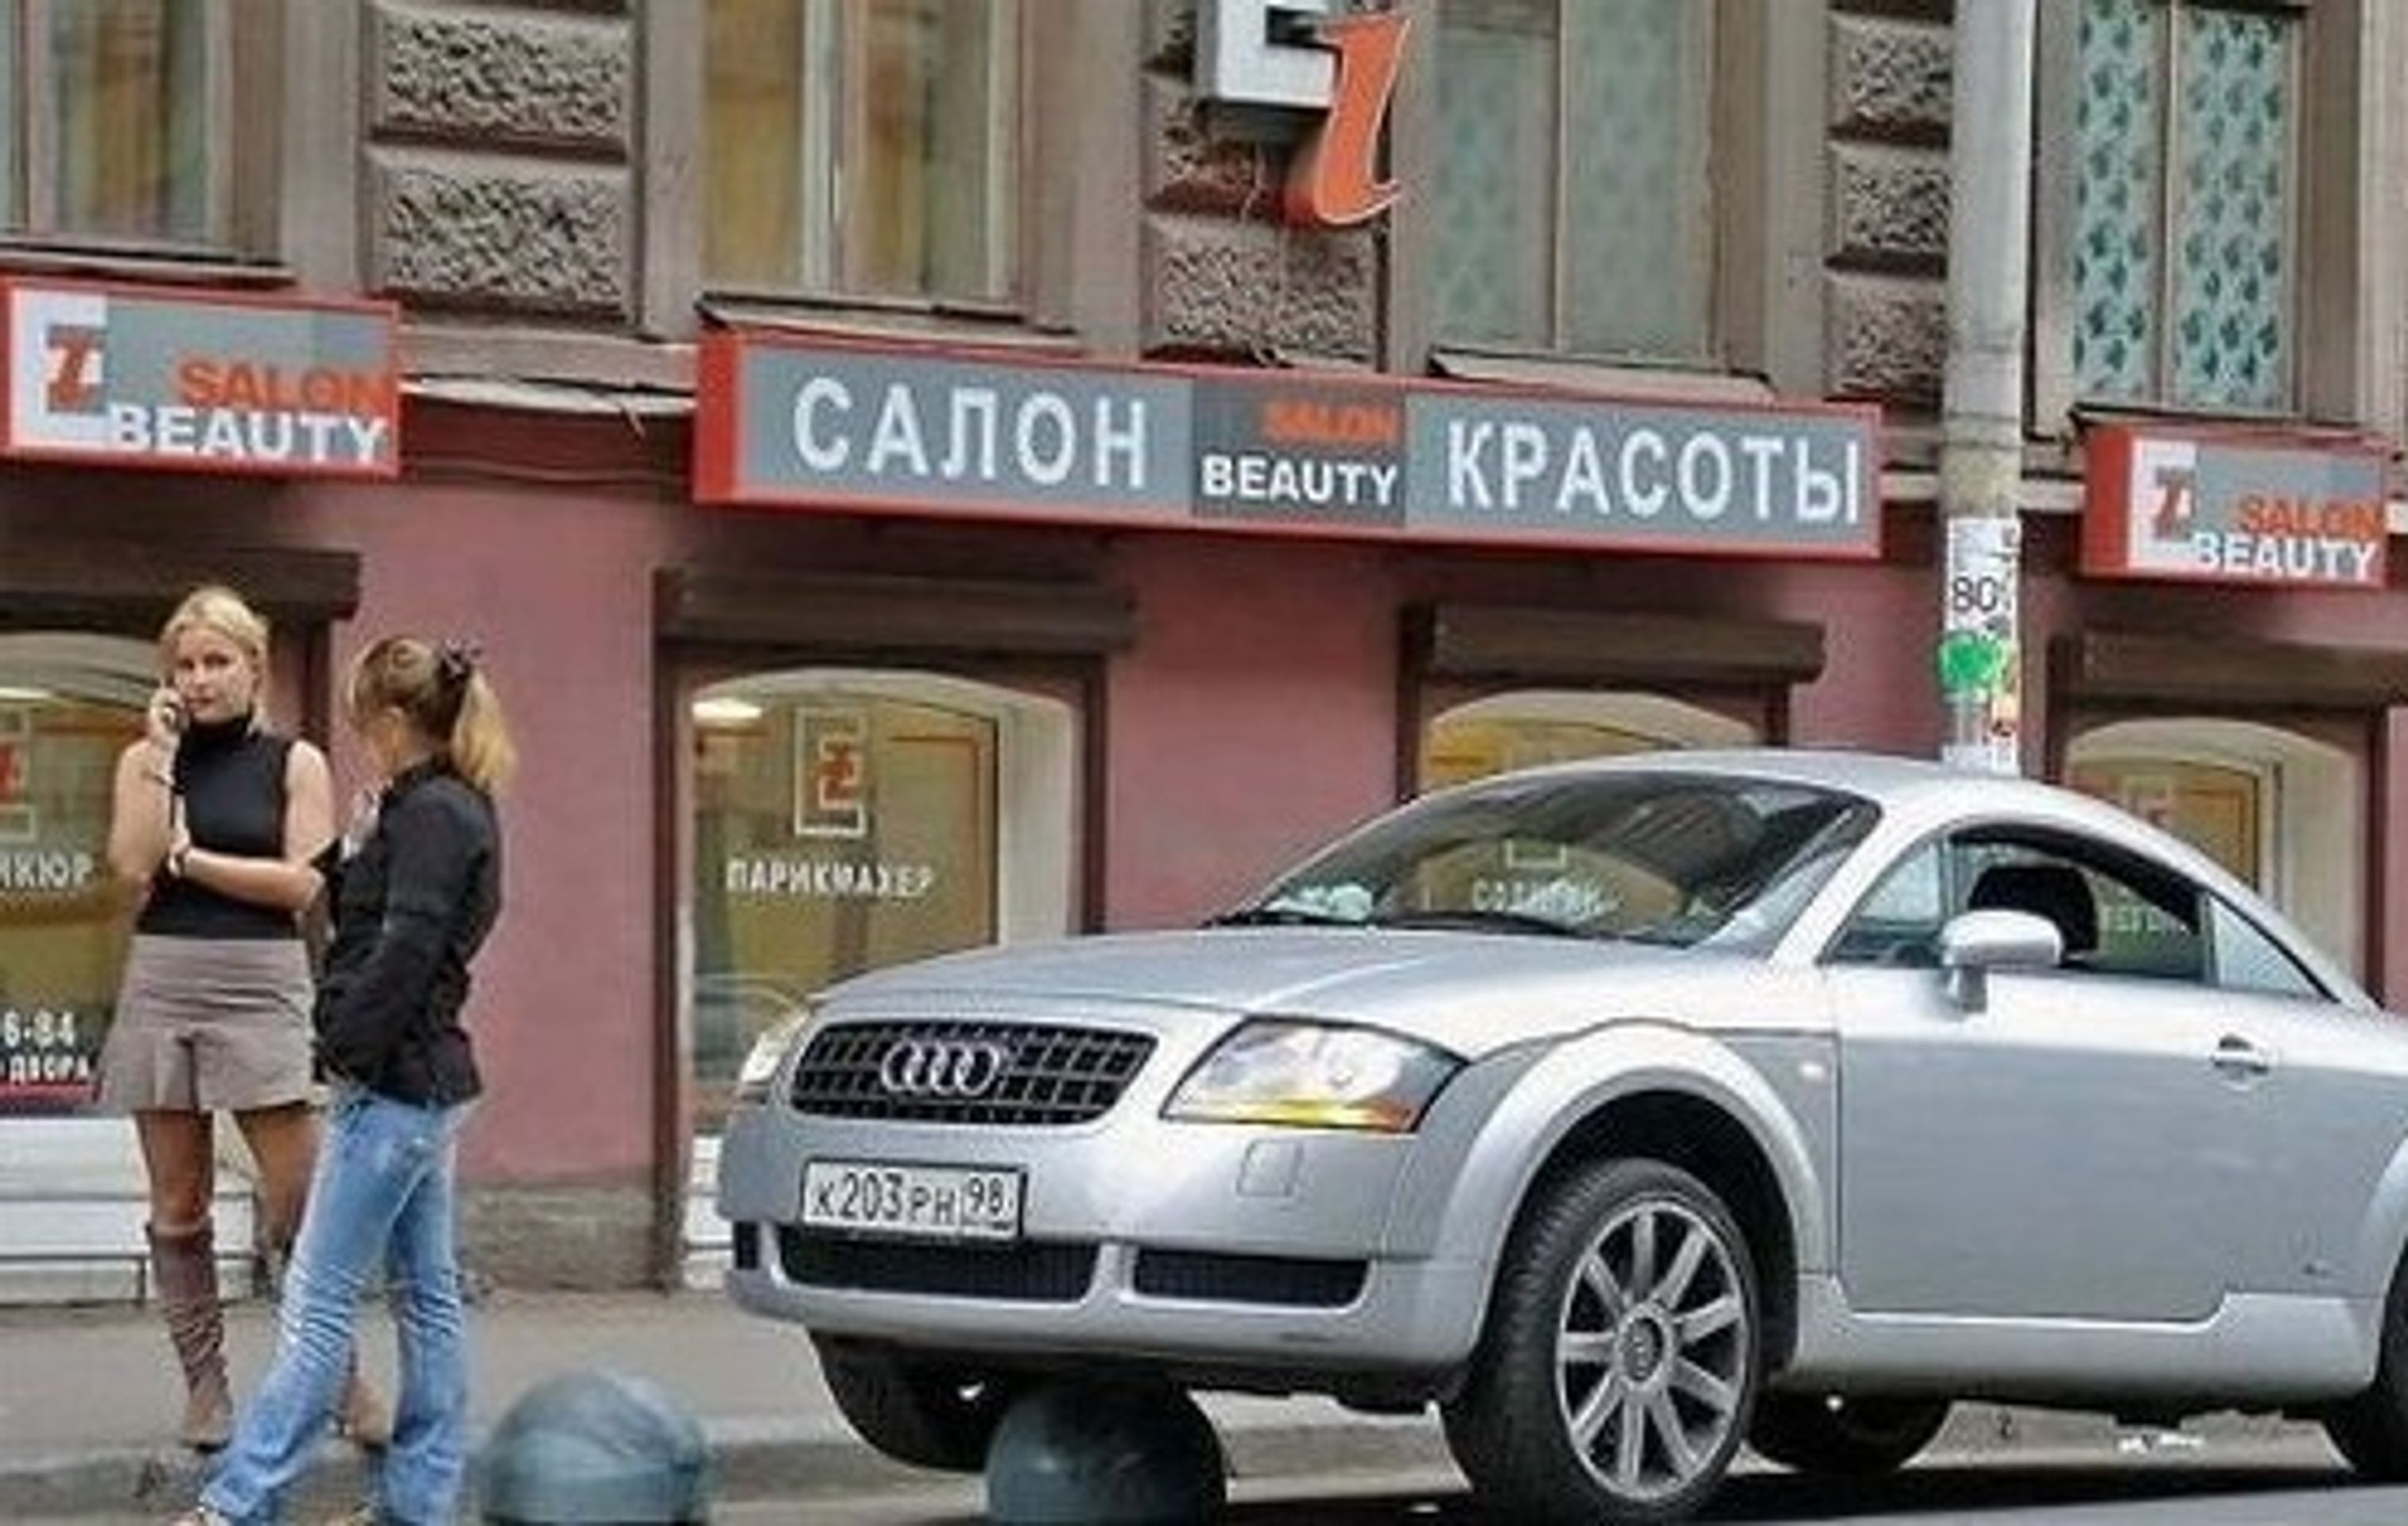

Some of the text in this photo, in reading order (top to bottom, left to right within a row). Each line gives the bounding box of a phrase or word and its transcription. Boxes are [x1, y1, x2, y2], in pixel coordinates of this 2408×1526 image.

[177, 357, 397, 409] SALON
[110, 404, 391, 464] BEAUTY
[793, 376, 1858, 525] САЛОН КРАСОТЫ
[1201, 454, 1398, 505] BEAUTY
[2193, 531, 2378, 582] BEAUTY
[725, 858, 936, 898] ПАРИКМАХЕР
